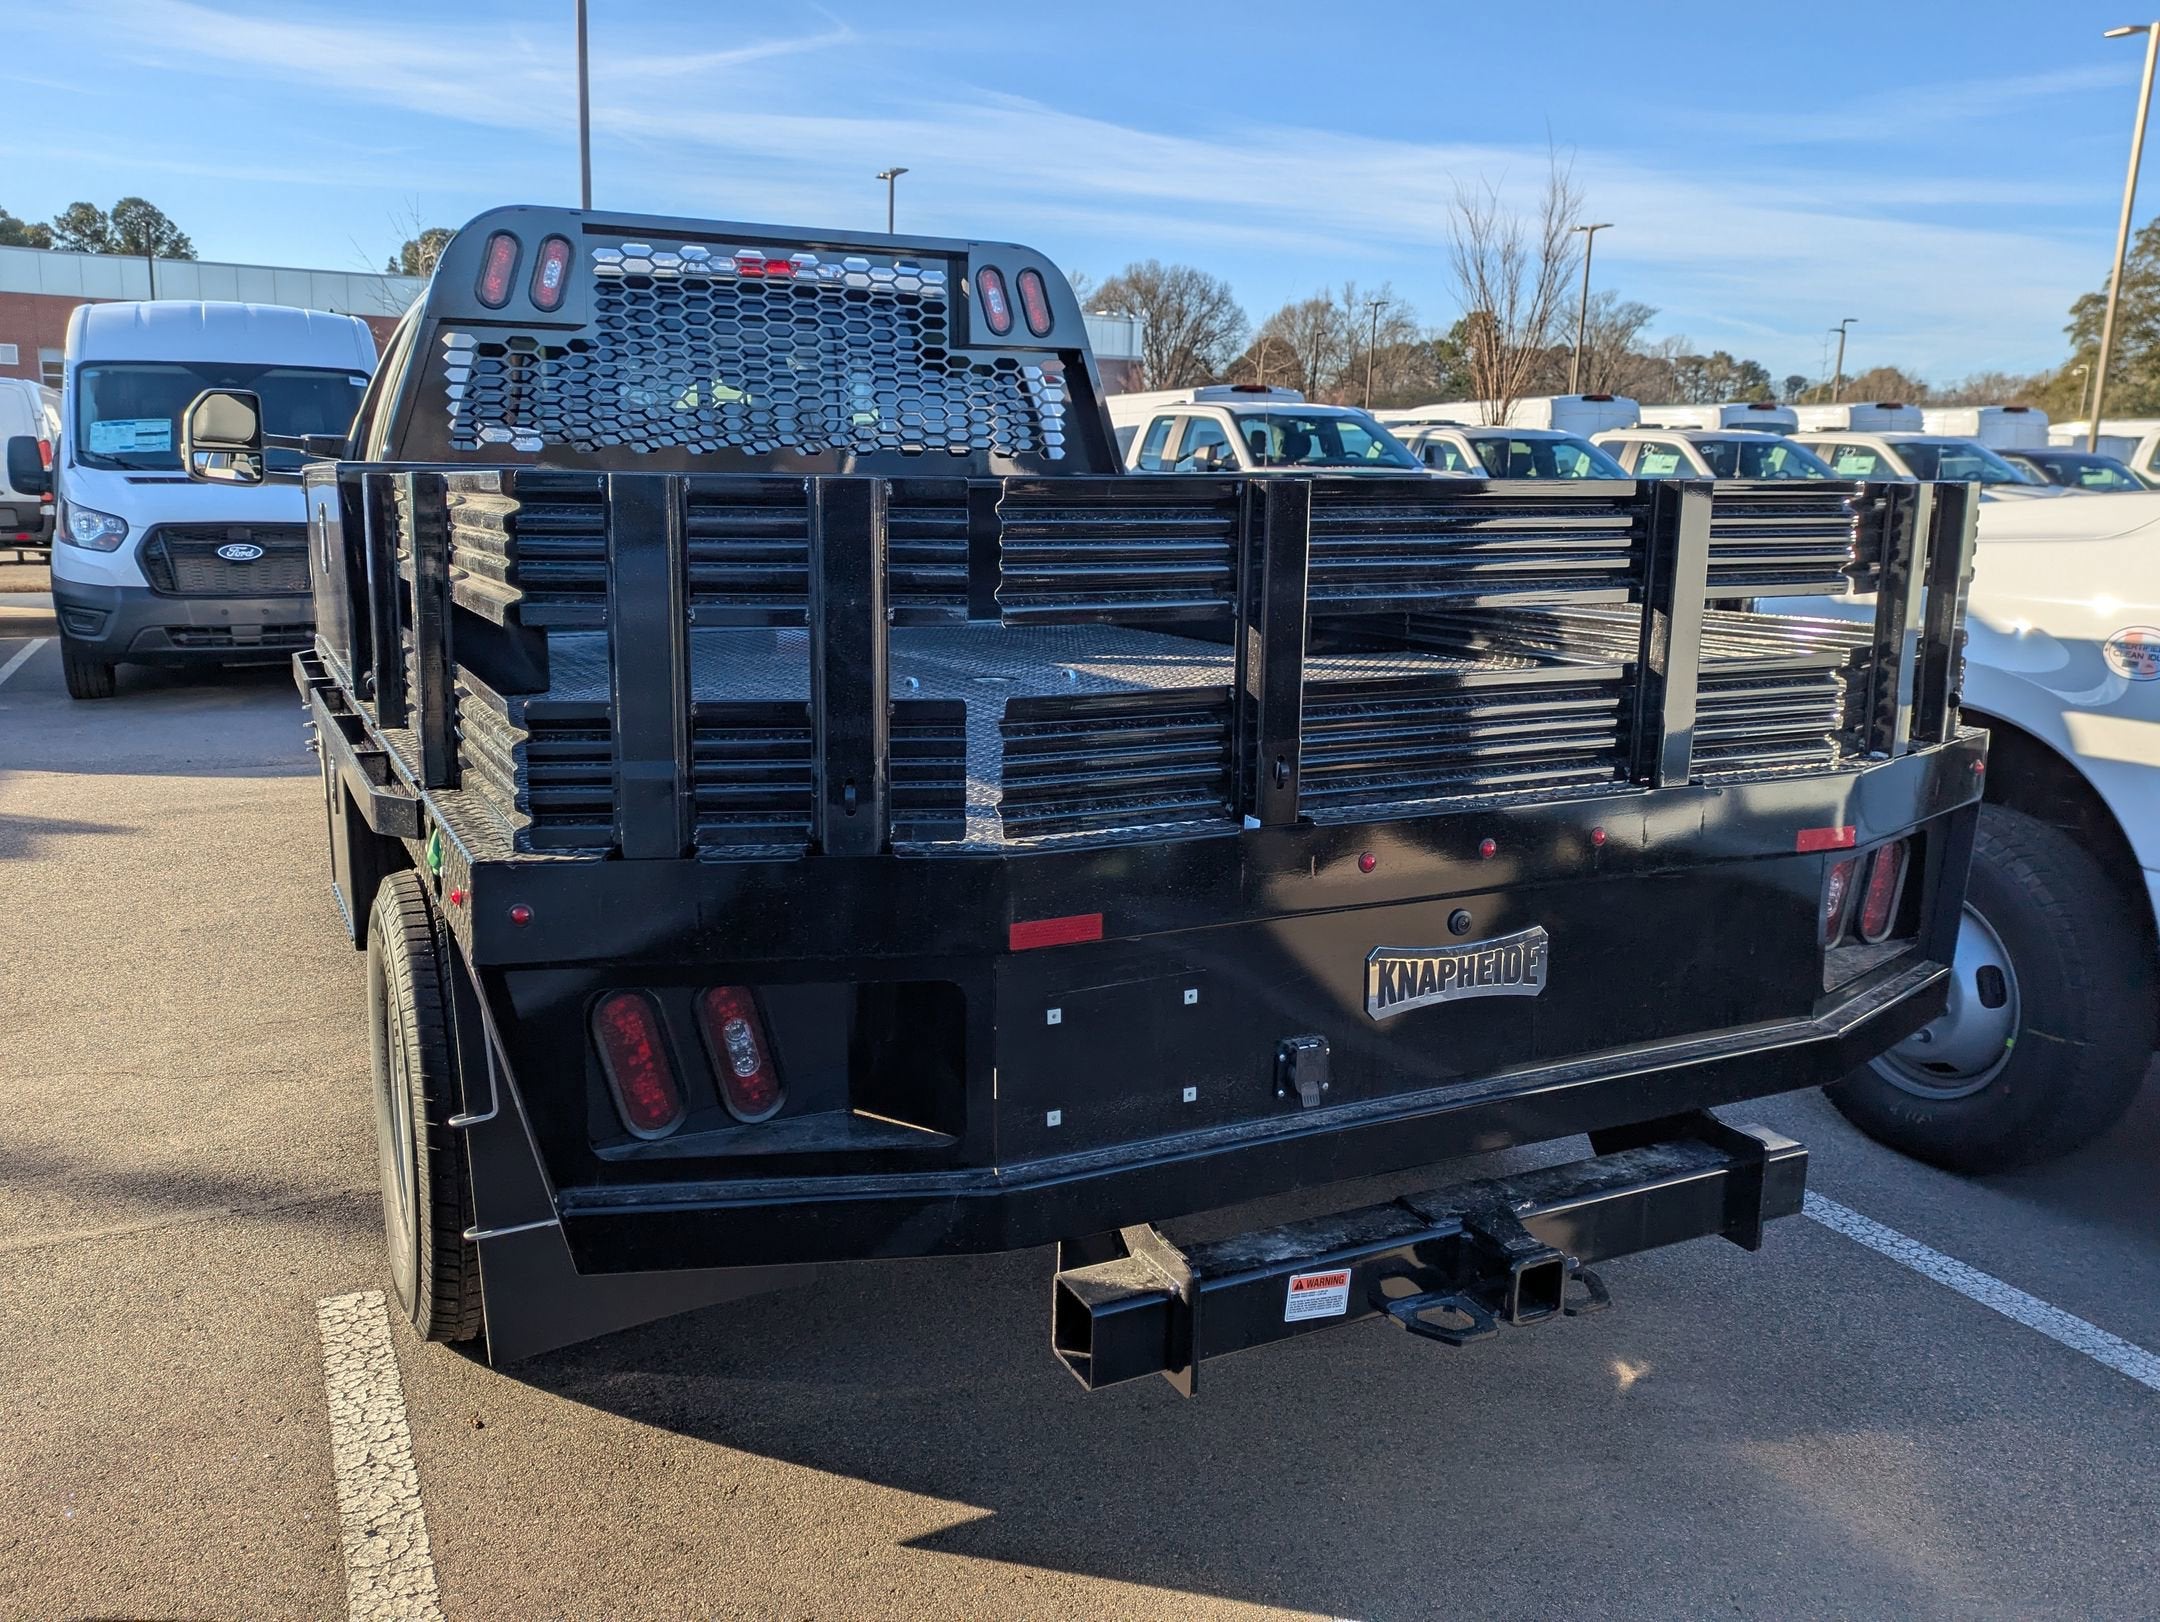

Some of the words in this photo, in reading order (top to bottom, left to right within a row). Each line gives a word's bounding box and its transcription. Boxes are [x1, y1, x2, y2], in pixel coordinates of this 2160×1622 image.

[226, 546, 255, 557] Ford
[2119, 642, 2160, 653] CERTIFIE
[1377, 937, 1541, 1009] KNAPHEIDE
[1306, 1275, 1345, 1288] WARNING
